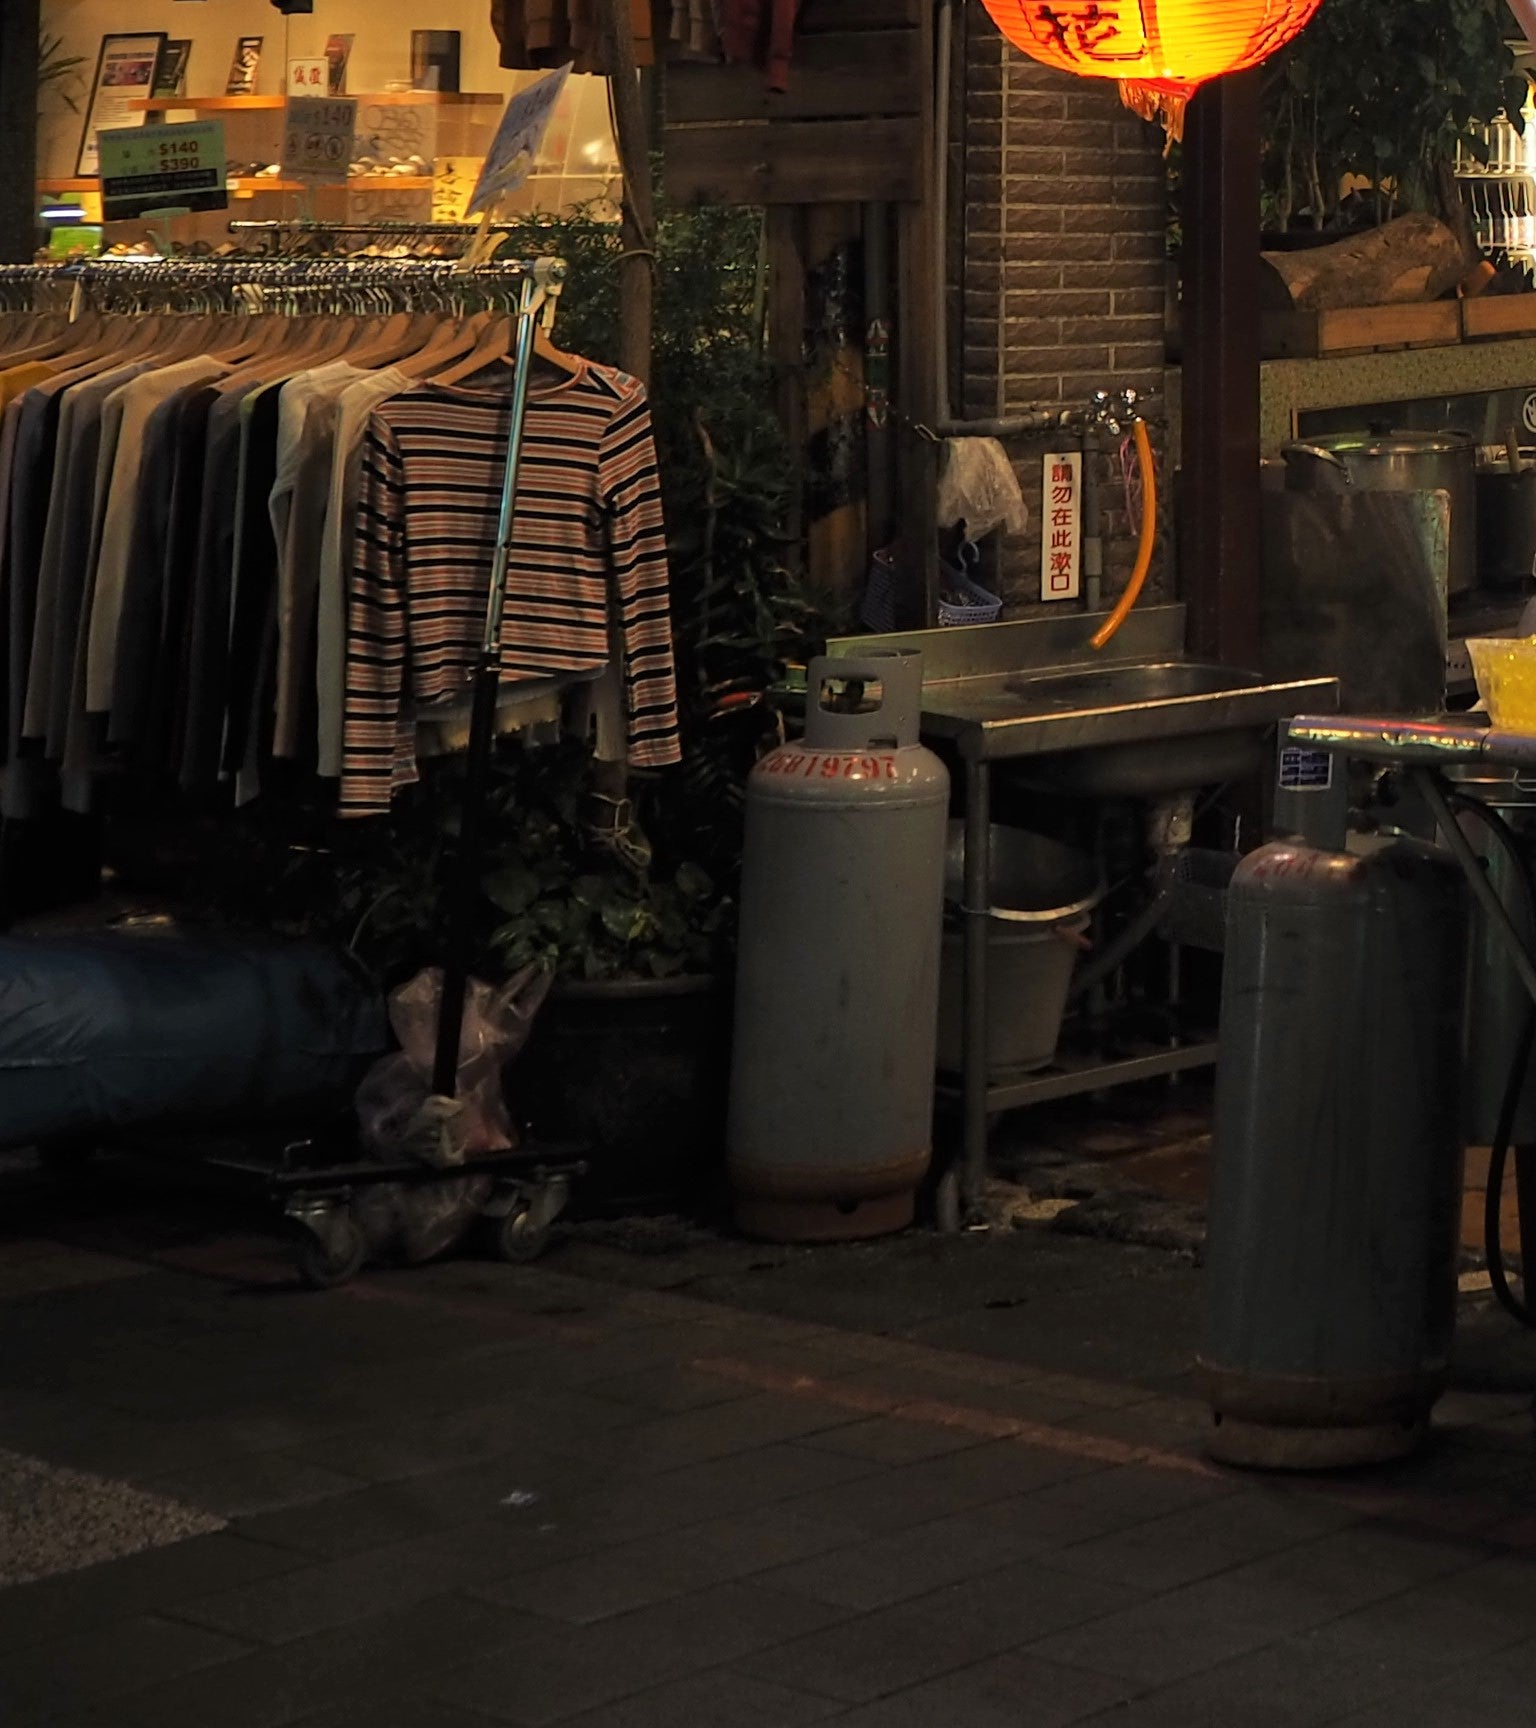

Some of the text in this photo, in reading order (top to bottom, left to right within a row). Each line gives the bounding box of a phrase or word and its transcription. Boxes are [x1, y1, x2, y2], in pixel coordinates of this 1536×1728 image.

[1050, 463, 1074, 592] 請勿在此漱口
